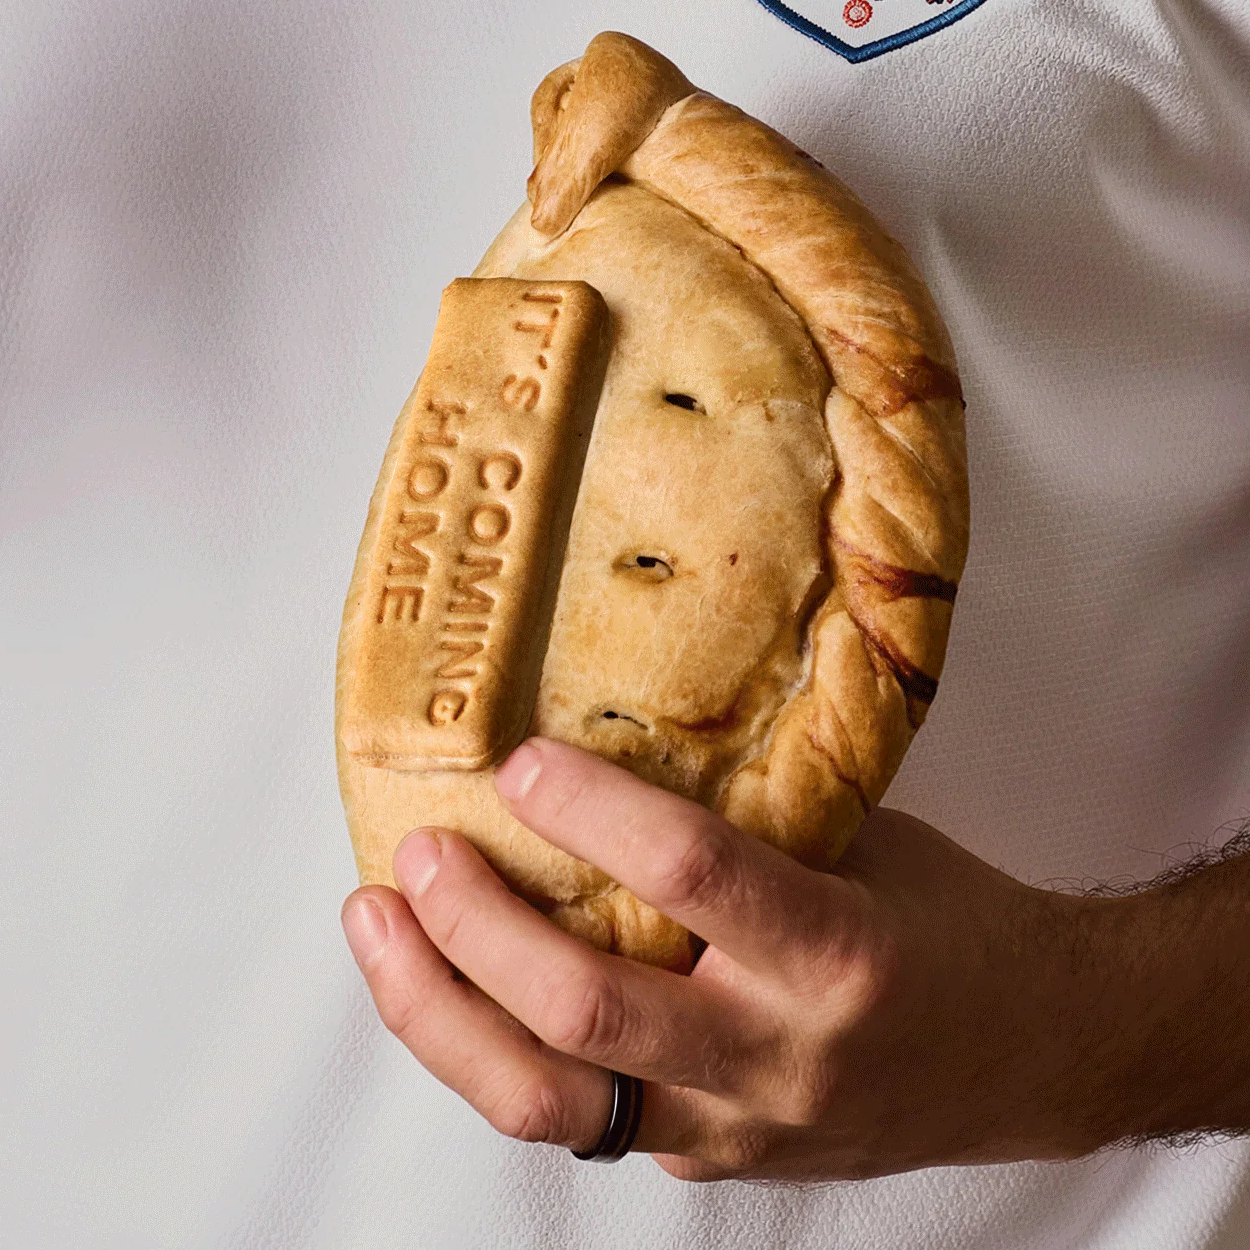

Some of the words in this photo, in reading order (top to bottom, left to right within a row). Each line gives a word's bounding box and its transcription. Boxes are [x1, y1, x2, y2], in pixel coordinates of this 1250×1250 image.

[501, 290, 565, 412] IT'S
[377, 397, 468, 625] HOME
[426, 450, 523, 728] COMING
